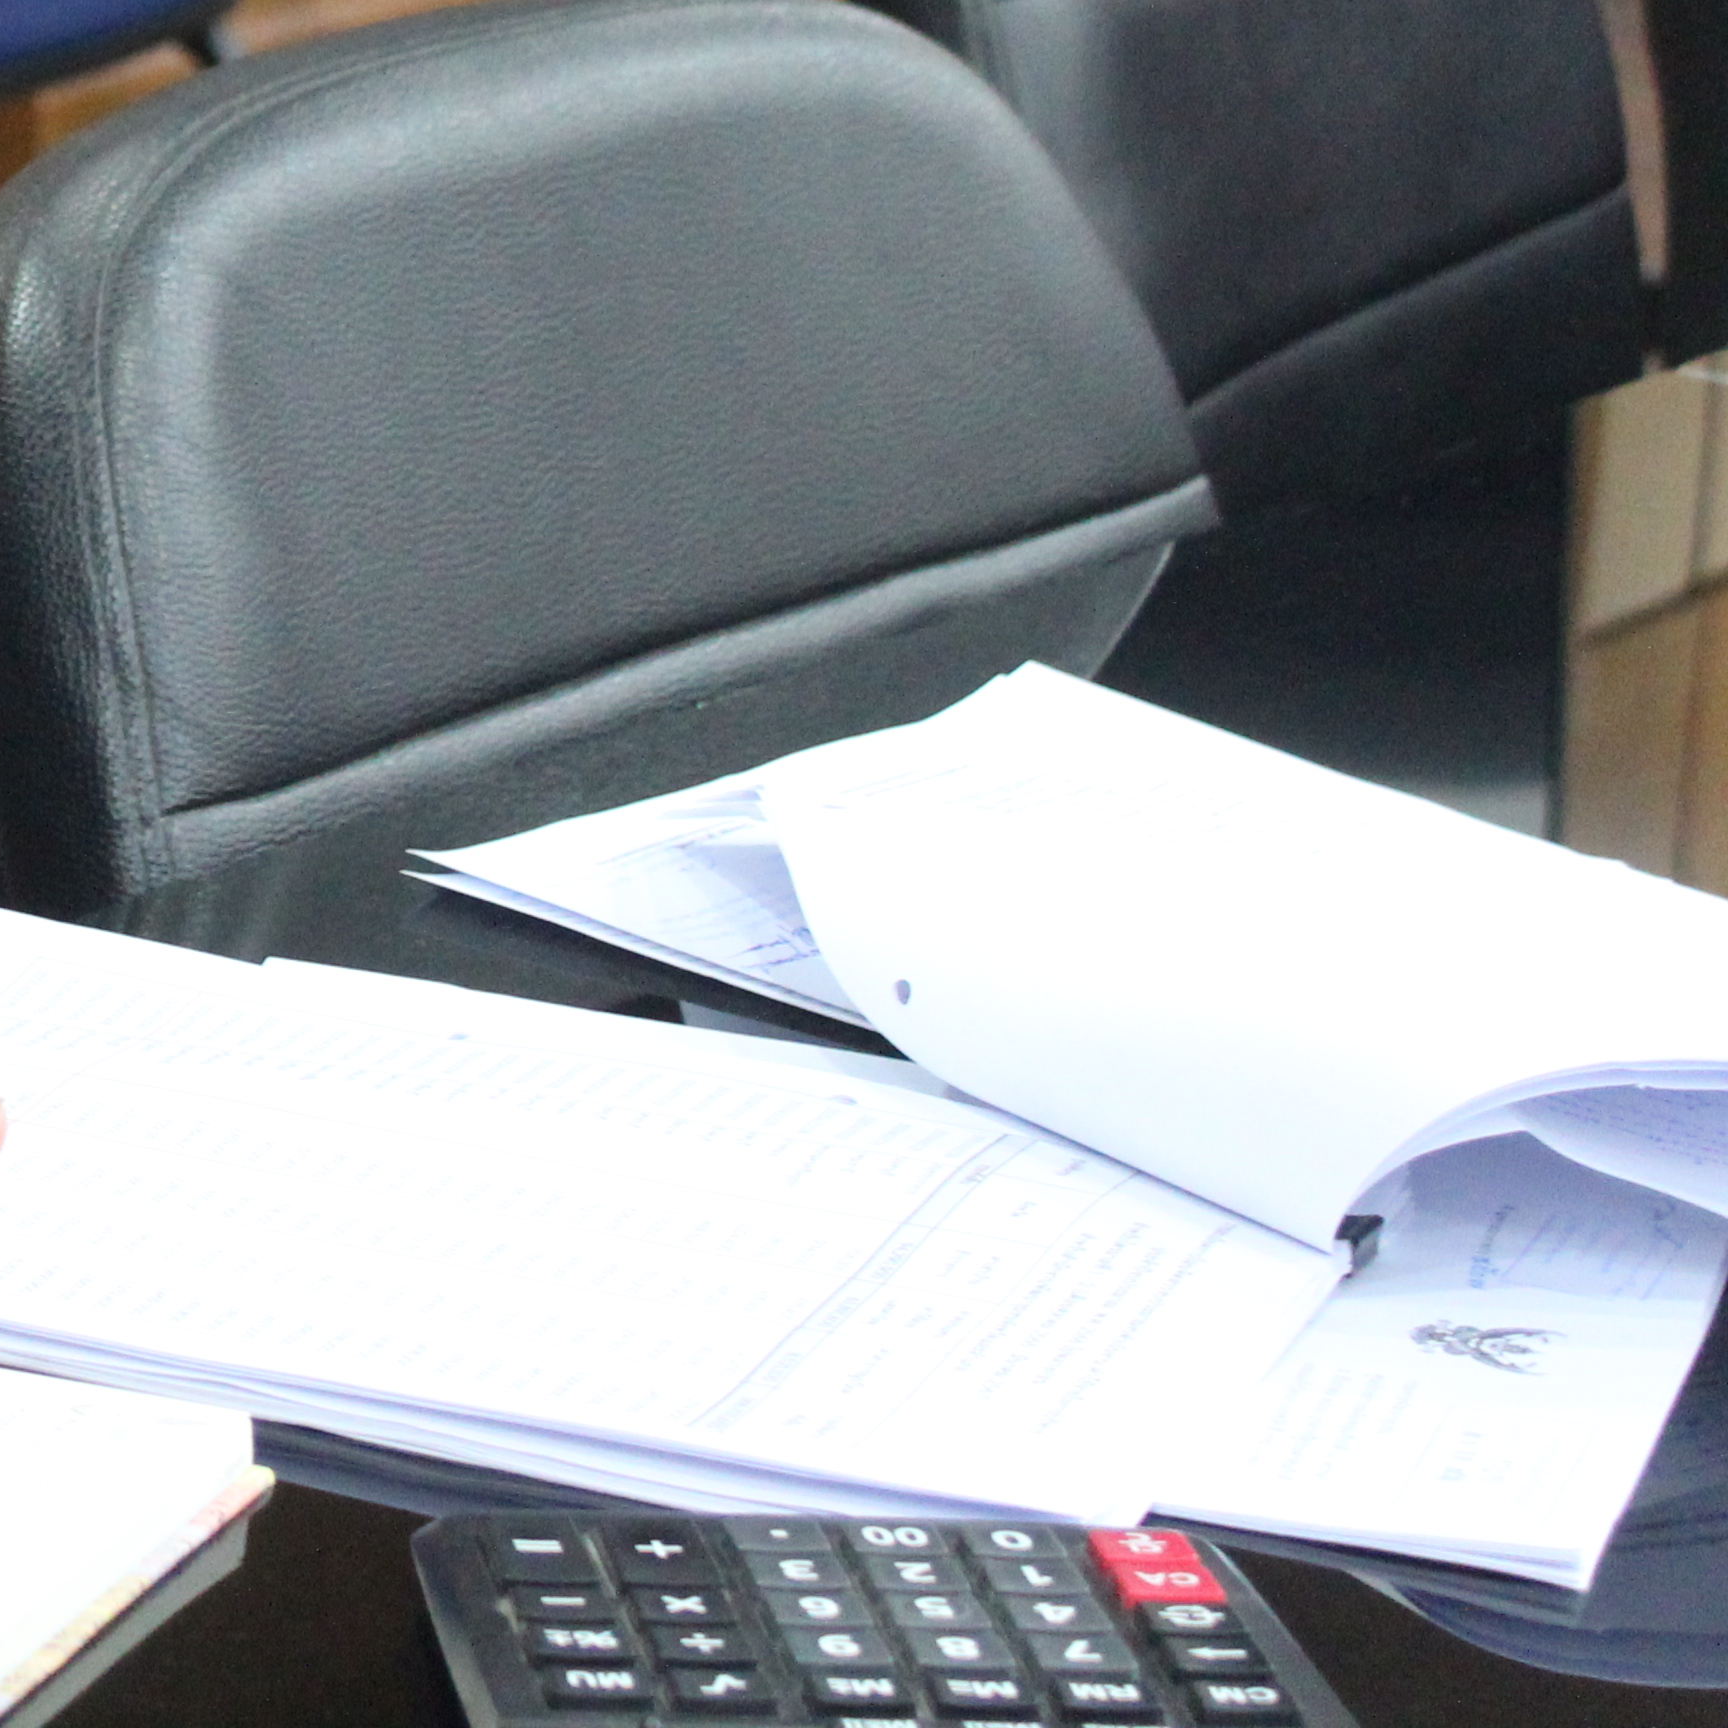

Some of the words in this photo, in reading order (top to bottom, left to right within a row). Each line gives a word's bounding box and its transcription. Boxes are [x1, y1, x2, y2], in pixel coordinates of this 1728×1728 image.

[861, 1525, 929, 1548] 00
[991, 1529, 1033, 1551] 0
[779, 1559, 819, 1582] 3
[894, 1561, 936, 1585] 2
[1021, 1565, 1053, 1588] 1
[1134, 1571, 1200, 1587] CA
[798, 1596, 841, 1620] 6
[914, 1596, 955, 1621] 5
[1033, 1602, 1076, 1625] 4
[818, 1634, 861, 1658] 9
[936, 1636, 980, 1661] 8
[1064, 1640, 1102, 1663] 7
[566, 1670, 635, 1690] MU
[1068, 1682, 1140, 1702] RM
[1207, 1685, 1279, 1705] CM
